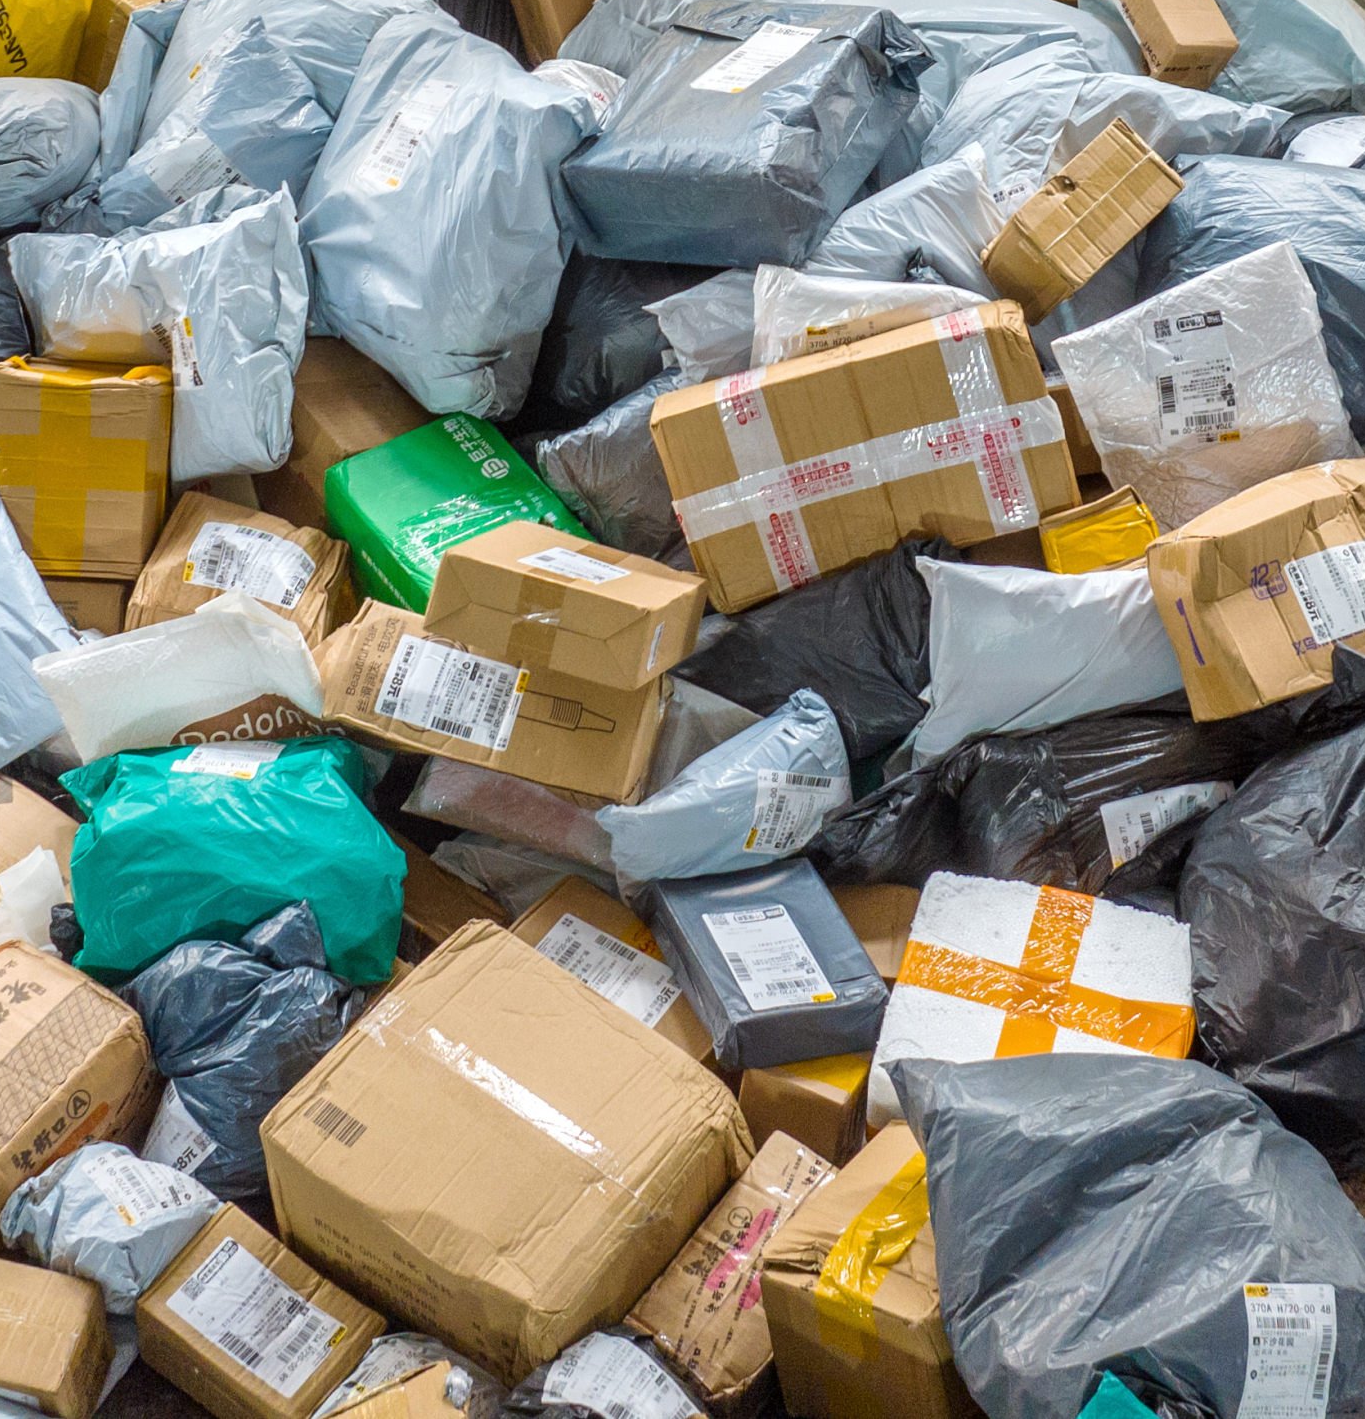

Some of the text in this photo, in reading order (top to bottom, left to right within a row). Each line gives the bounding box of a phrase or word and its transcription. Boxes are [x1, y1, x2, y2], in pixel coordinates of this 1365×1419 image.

[442, 417, 489, 463] 巨子生物
[1248, 562, 1271, 590] 12
[11, 1116, 66, 1173] 老街口
[1249, 1302, 1273, 1315] 370A
[1276, 1302, 1316, 1315] H720-00
